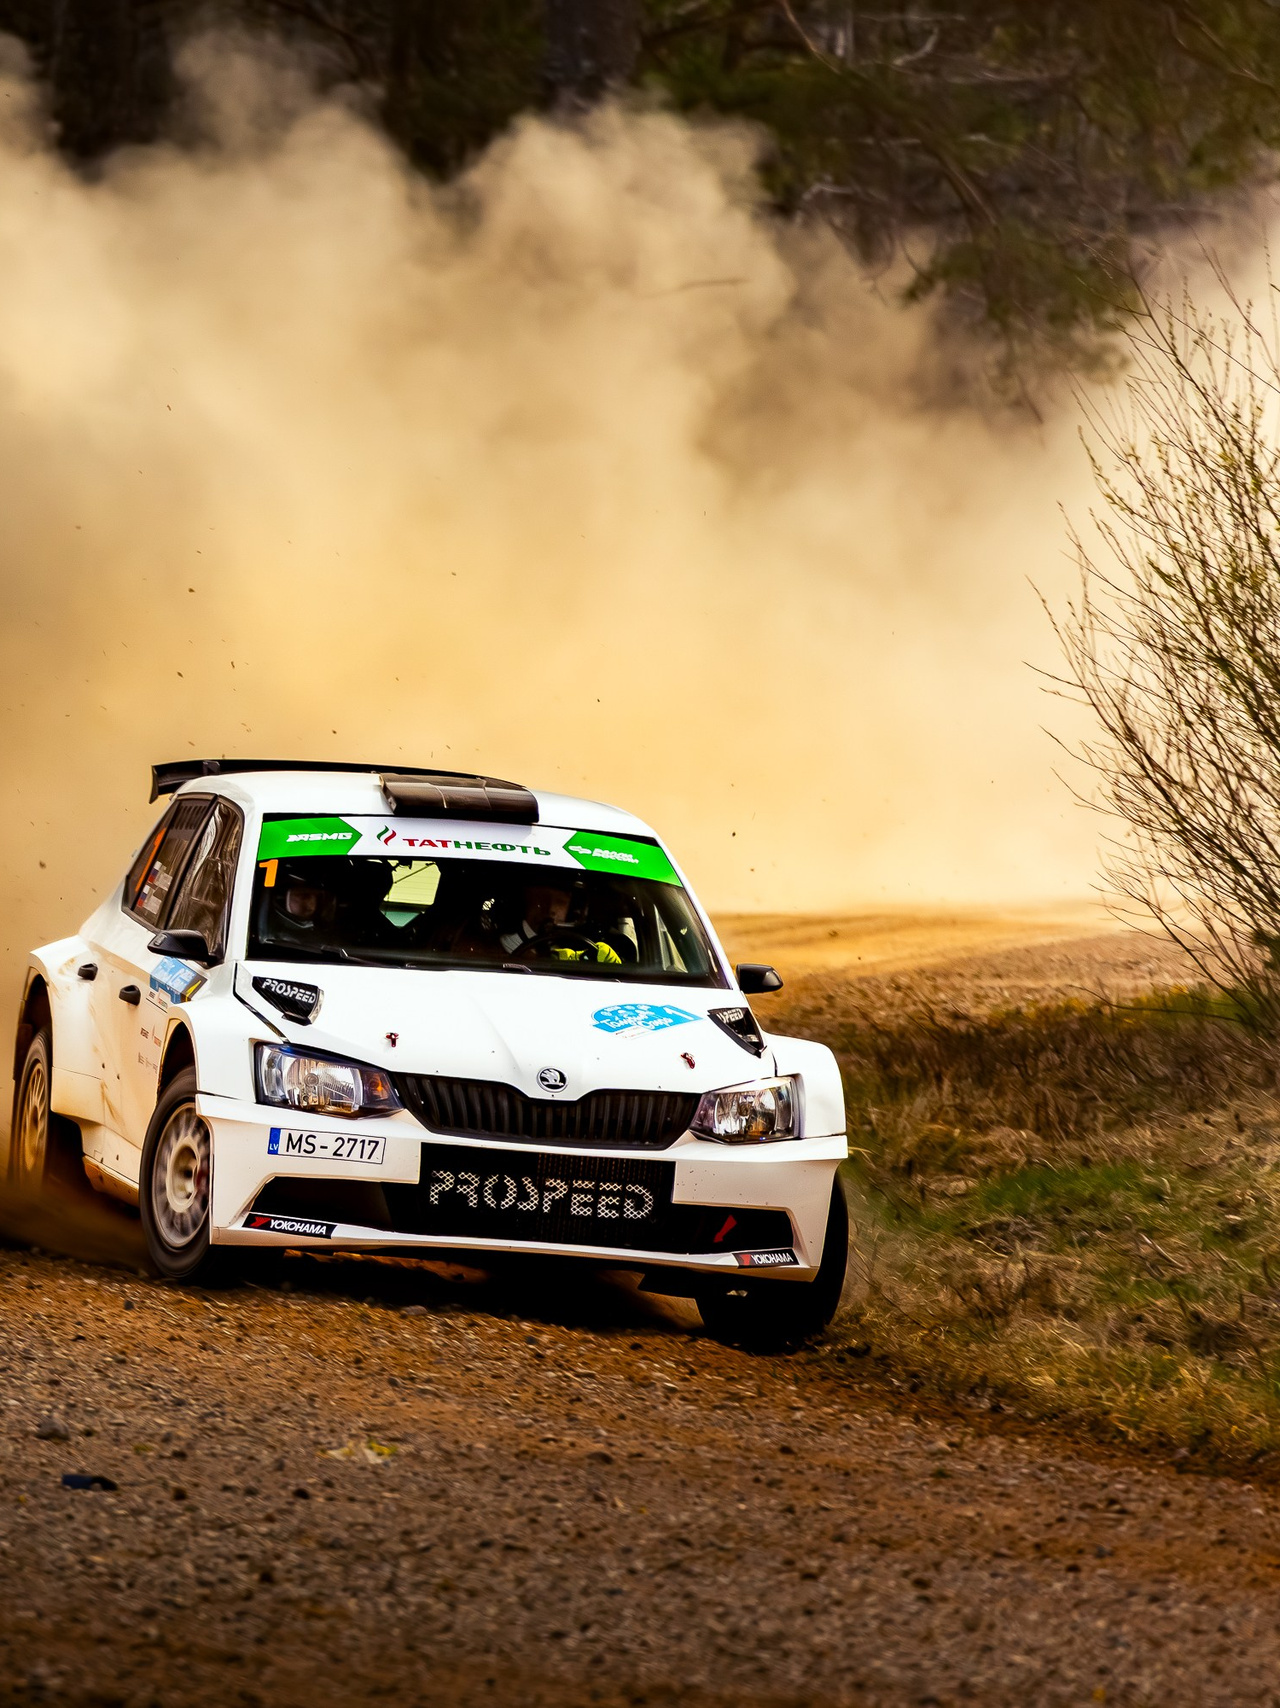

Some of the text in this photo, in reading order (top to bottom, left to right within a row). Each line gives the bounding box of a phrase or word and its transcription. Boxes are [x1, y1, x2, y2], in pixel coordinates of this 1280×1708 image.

[402, 838, 551, 856] ТАТНЕФТЬ
[259, 858, 279, 888] 1
[261, 978, 317, 1004] PROSPEED
[270, 1143, 279, 1151] LV
[430, 1170, 654, 1219] PROSPEED
[270, 1219, 327, 1235] YOKOHAMA
[751, 1252, 794, 1265] YOKOHAMA
